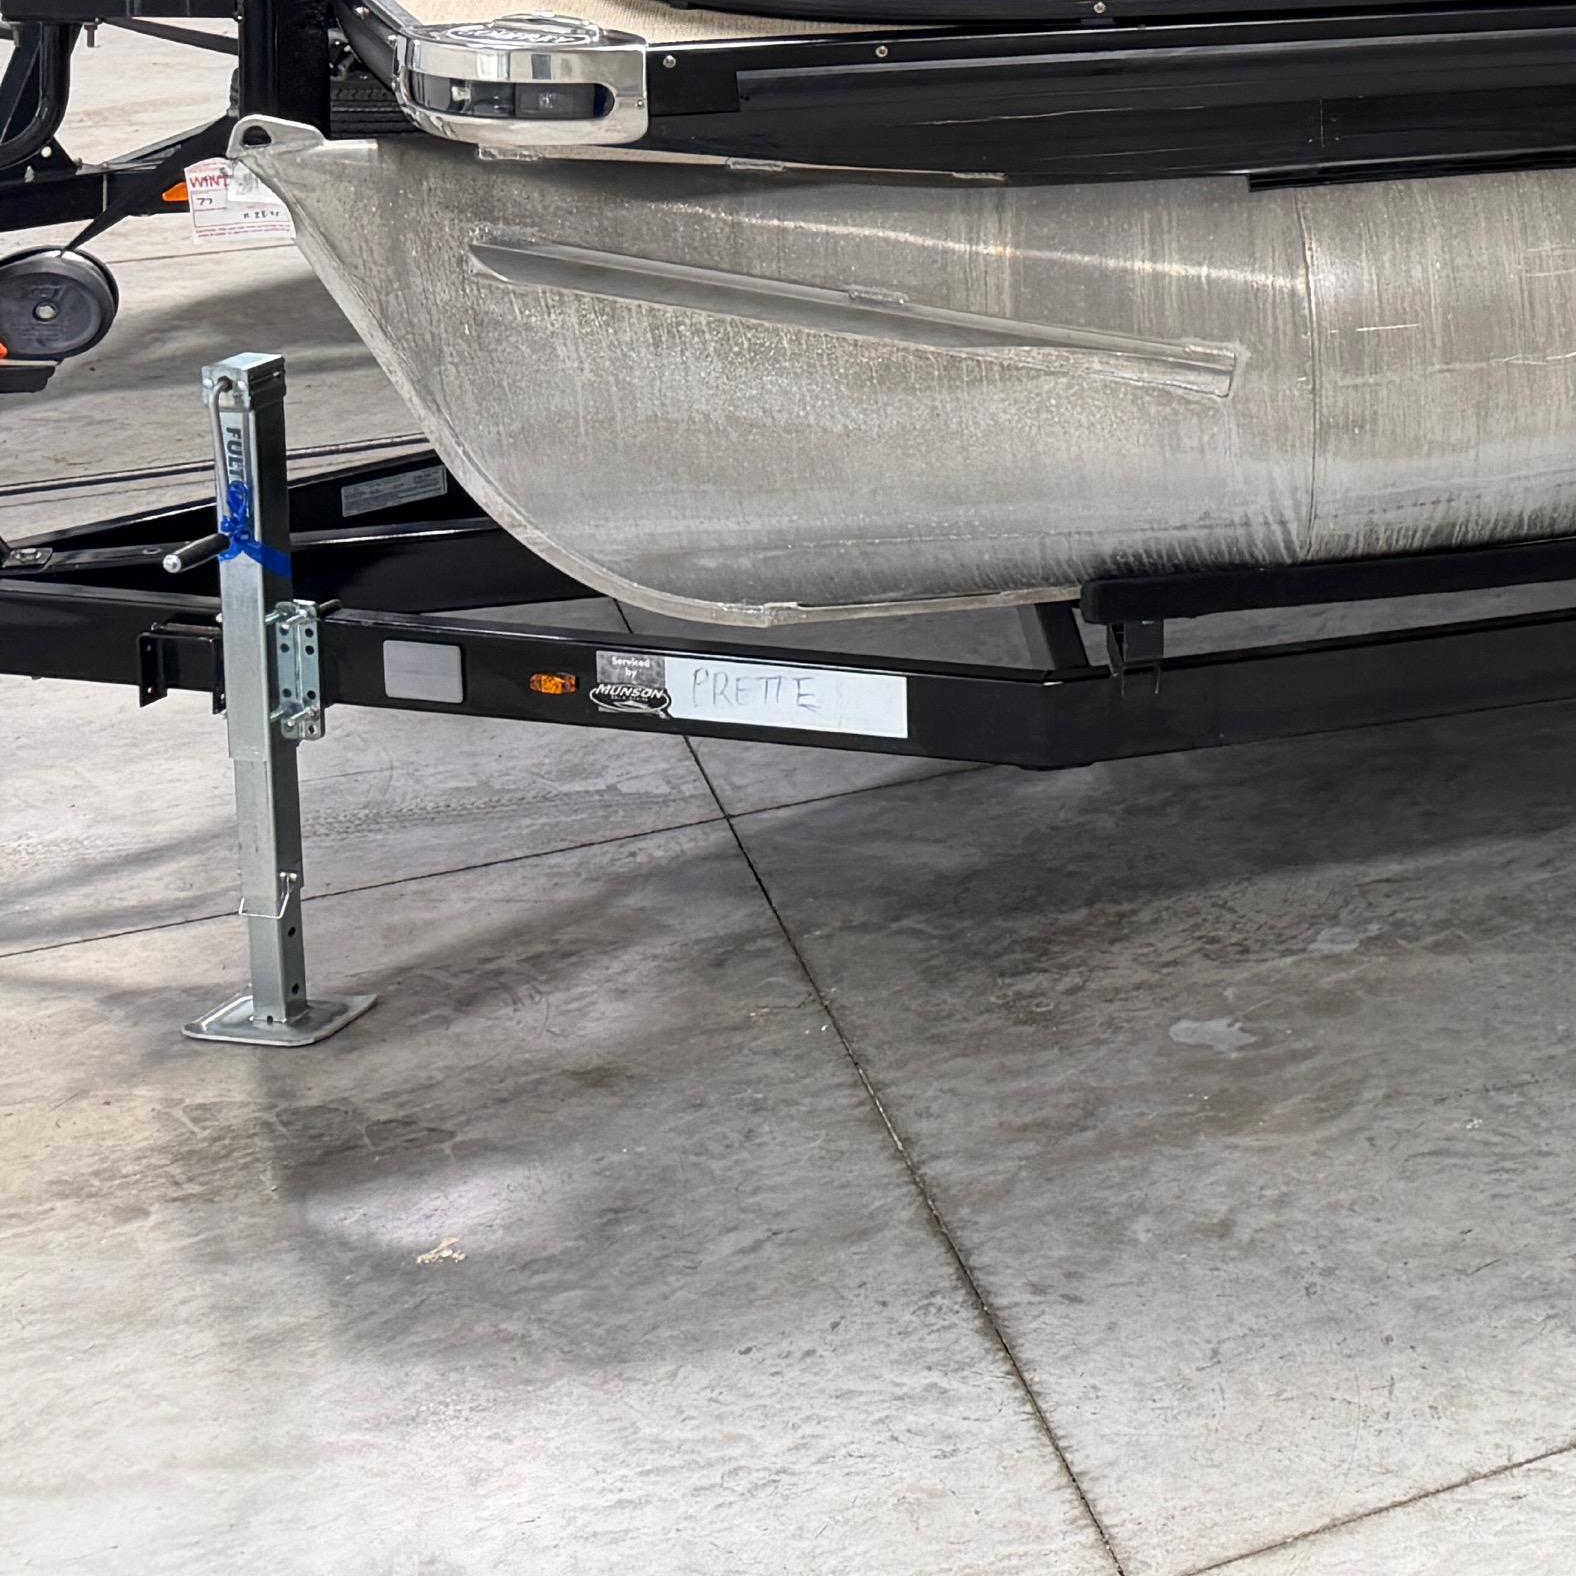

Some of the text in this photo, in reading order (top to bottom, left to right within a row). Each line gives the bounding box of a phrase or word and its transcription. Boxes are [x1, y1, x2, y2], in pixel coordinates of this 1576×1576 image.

[226, 426, 245, 482] FULT
[624, 666, 638, 678] by
[595, 683, 664, 699] MUNSON
